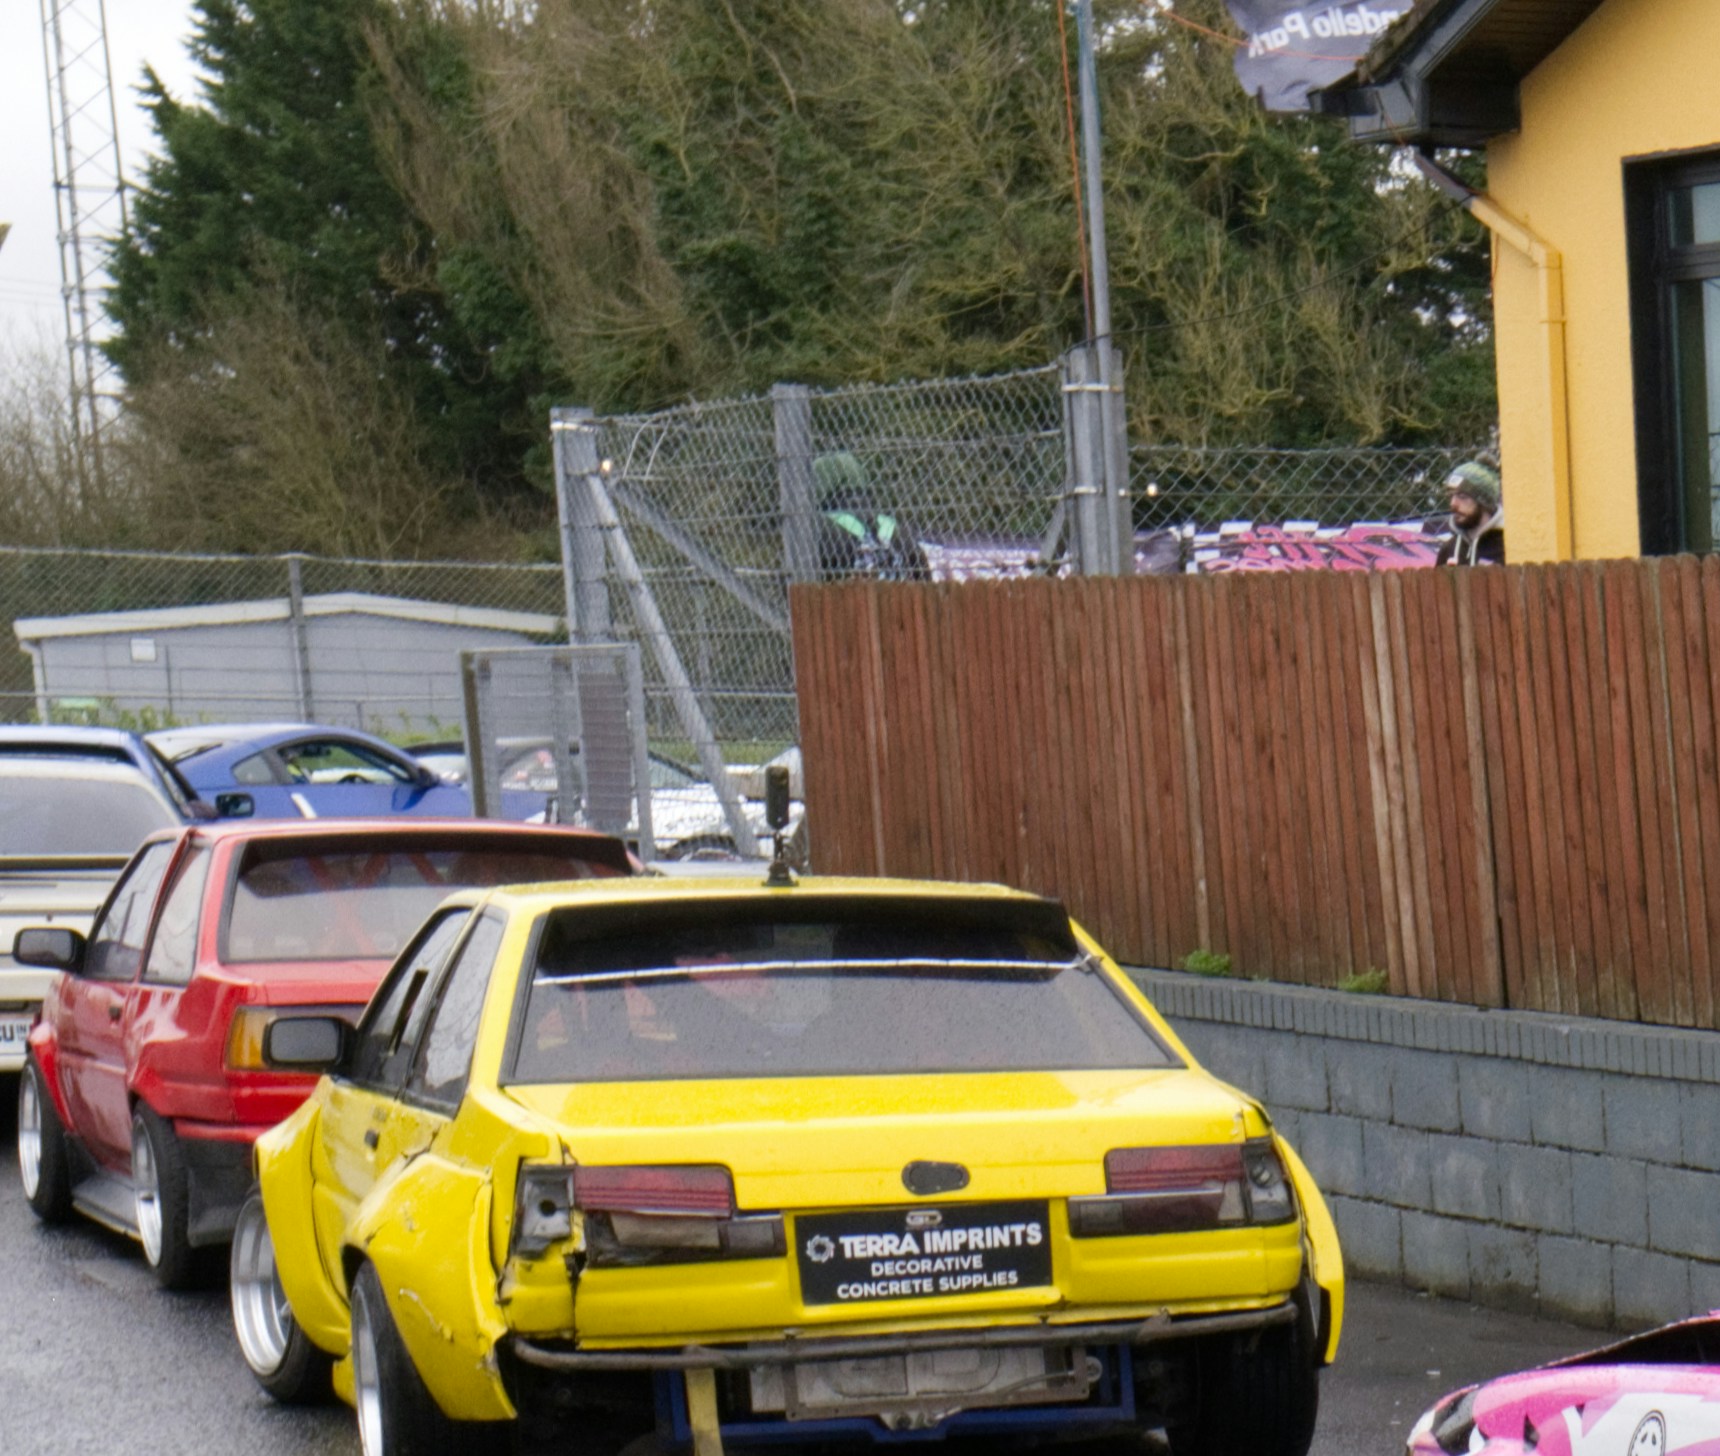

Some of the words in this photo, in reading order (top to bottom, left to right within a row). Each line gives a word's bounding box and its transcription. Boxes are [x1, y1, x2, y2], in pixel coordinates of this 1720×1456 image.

[839, 1233, 919, 1259] TERRA
[924, 1222, 1043, 1254] IMPRINTS
[871, 1254, 983, 1277] DECORATIVE
[837, 1277, 934, 1299] CONCRETE
[938, 1270, 1018, 1292] SUPPLIES
